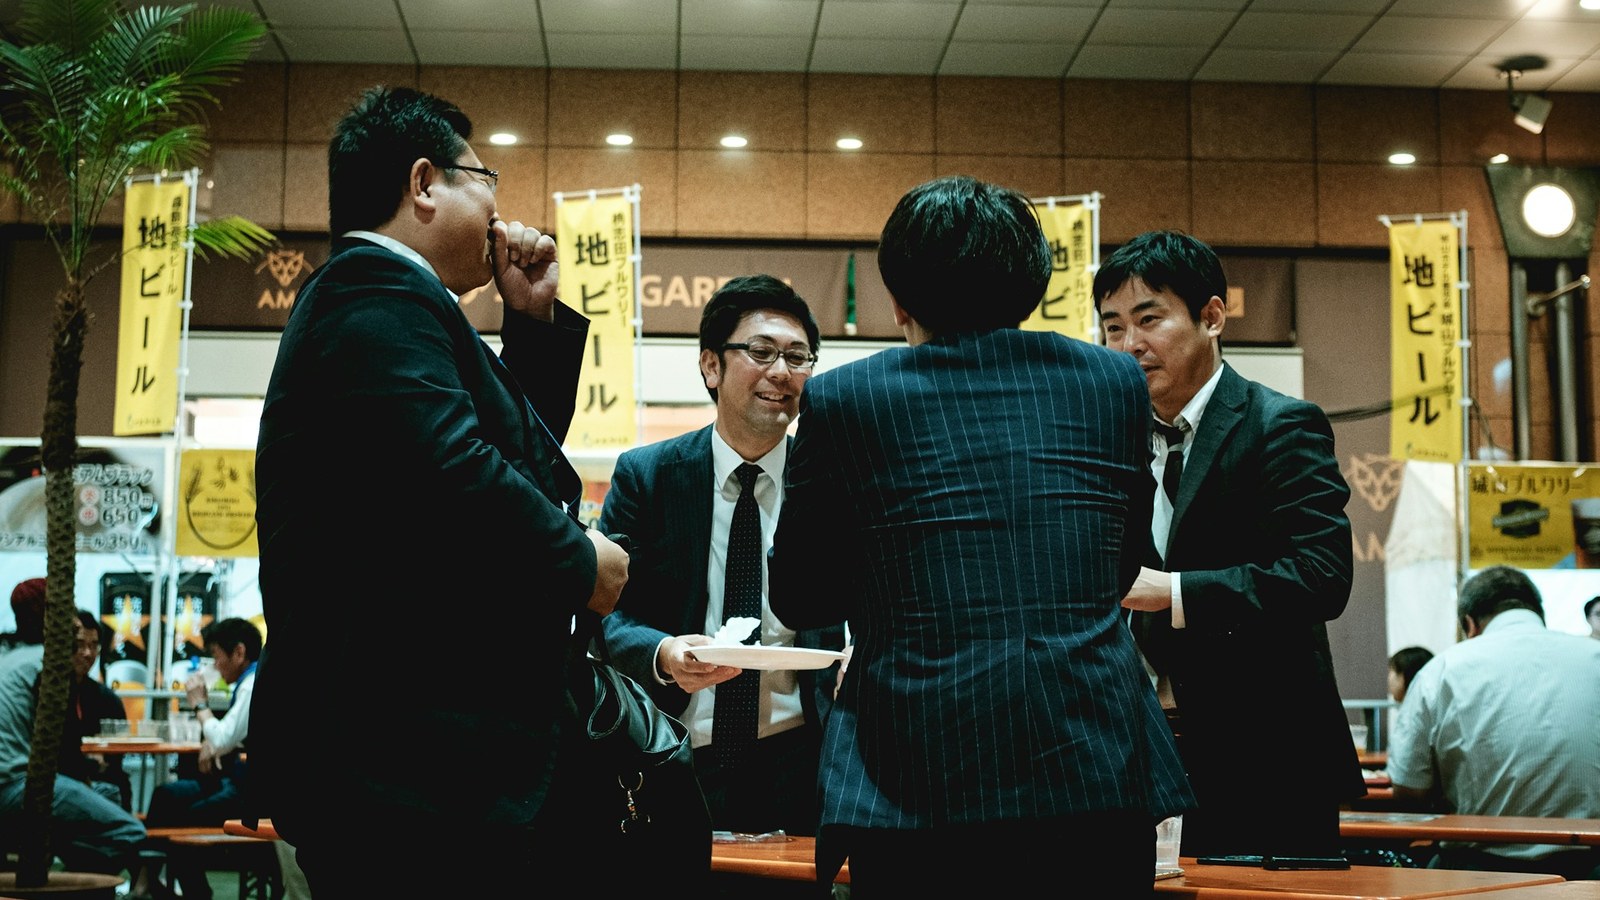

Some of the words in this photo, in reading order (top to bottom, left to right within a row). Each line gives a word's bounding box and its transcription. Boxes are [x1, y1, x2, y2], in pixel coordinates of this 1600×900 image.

[131, 215, 166, 394] 地ビール
[257, 288, 297, 309] AM
[575, 232, 617, 413] 地ビール
[1042, 238, 1071, 320] 地ビ
[1403, 255, 1440, 425] 地ビール
[1473, 473, 1582, 495] 城山ブルワリー
